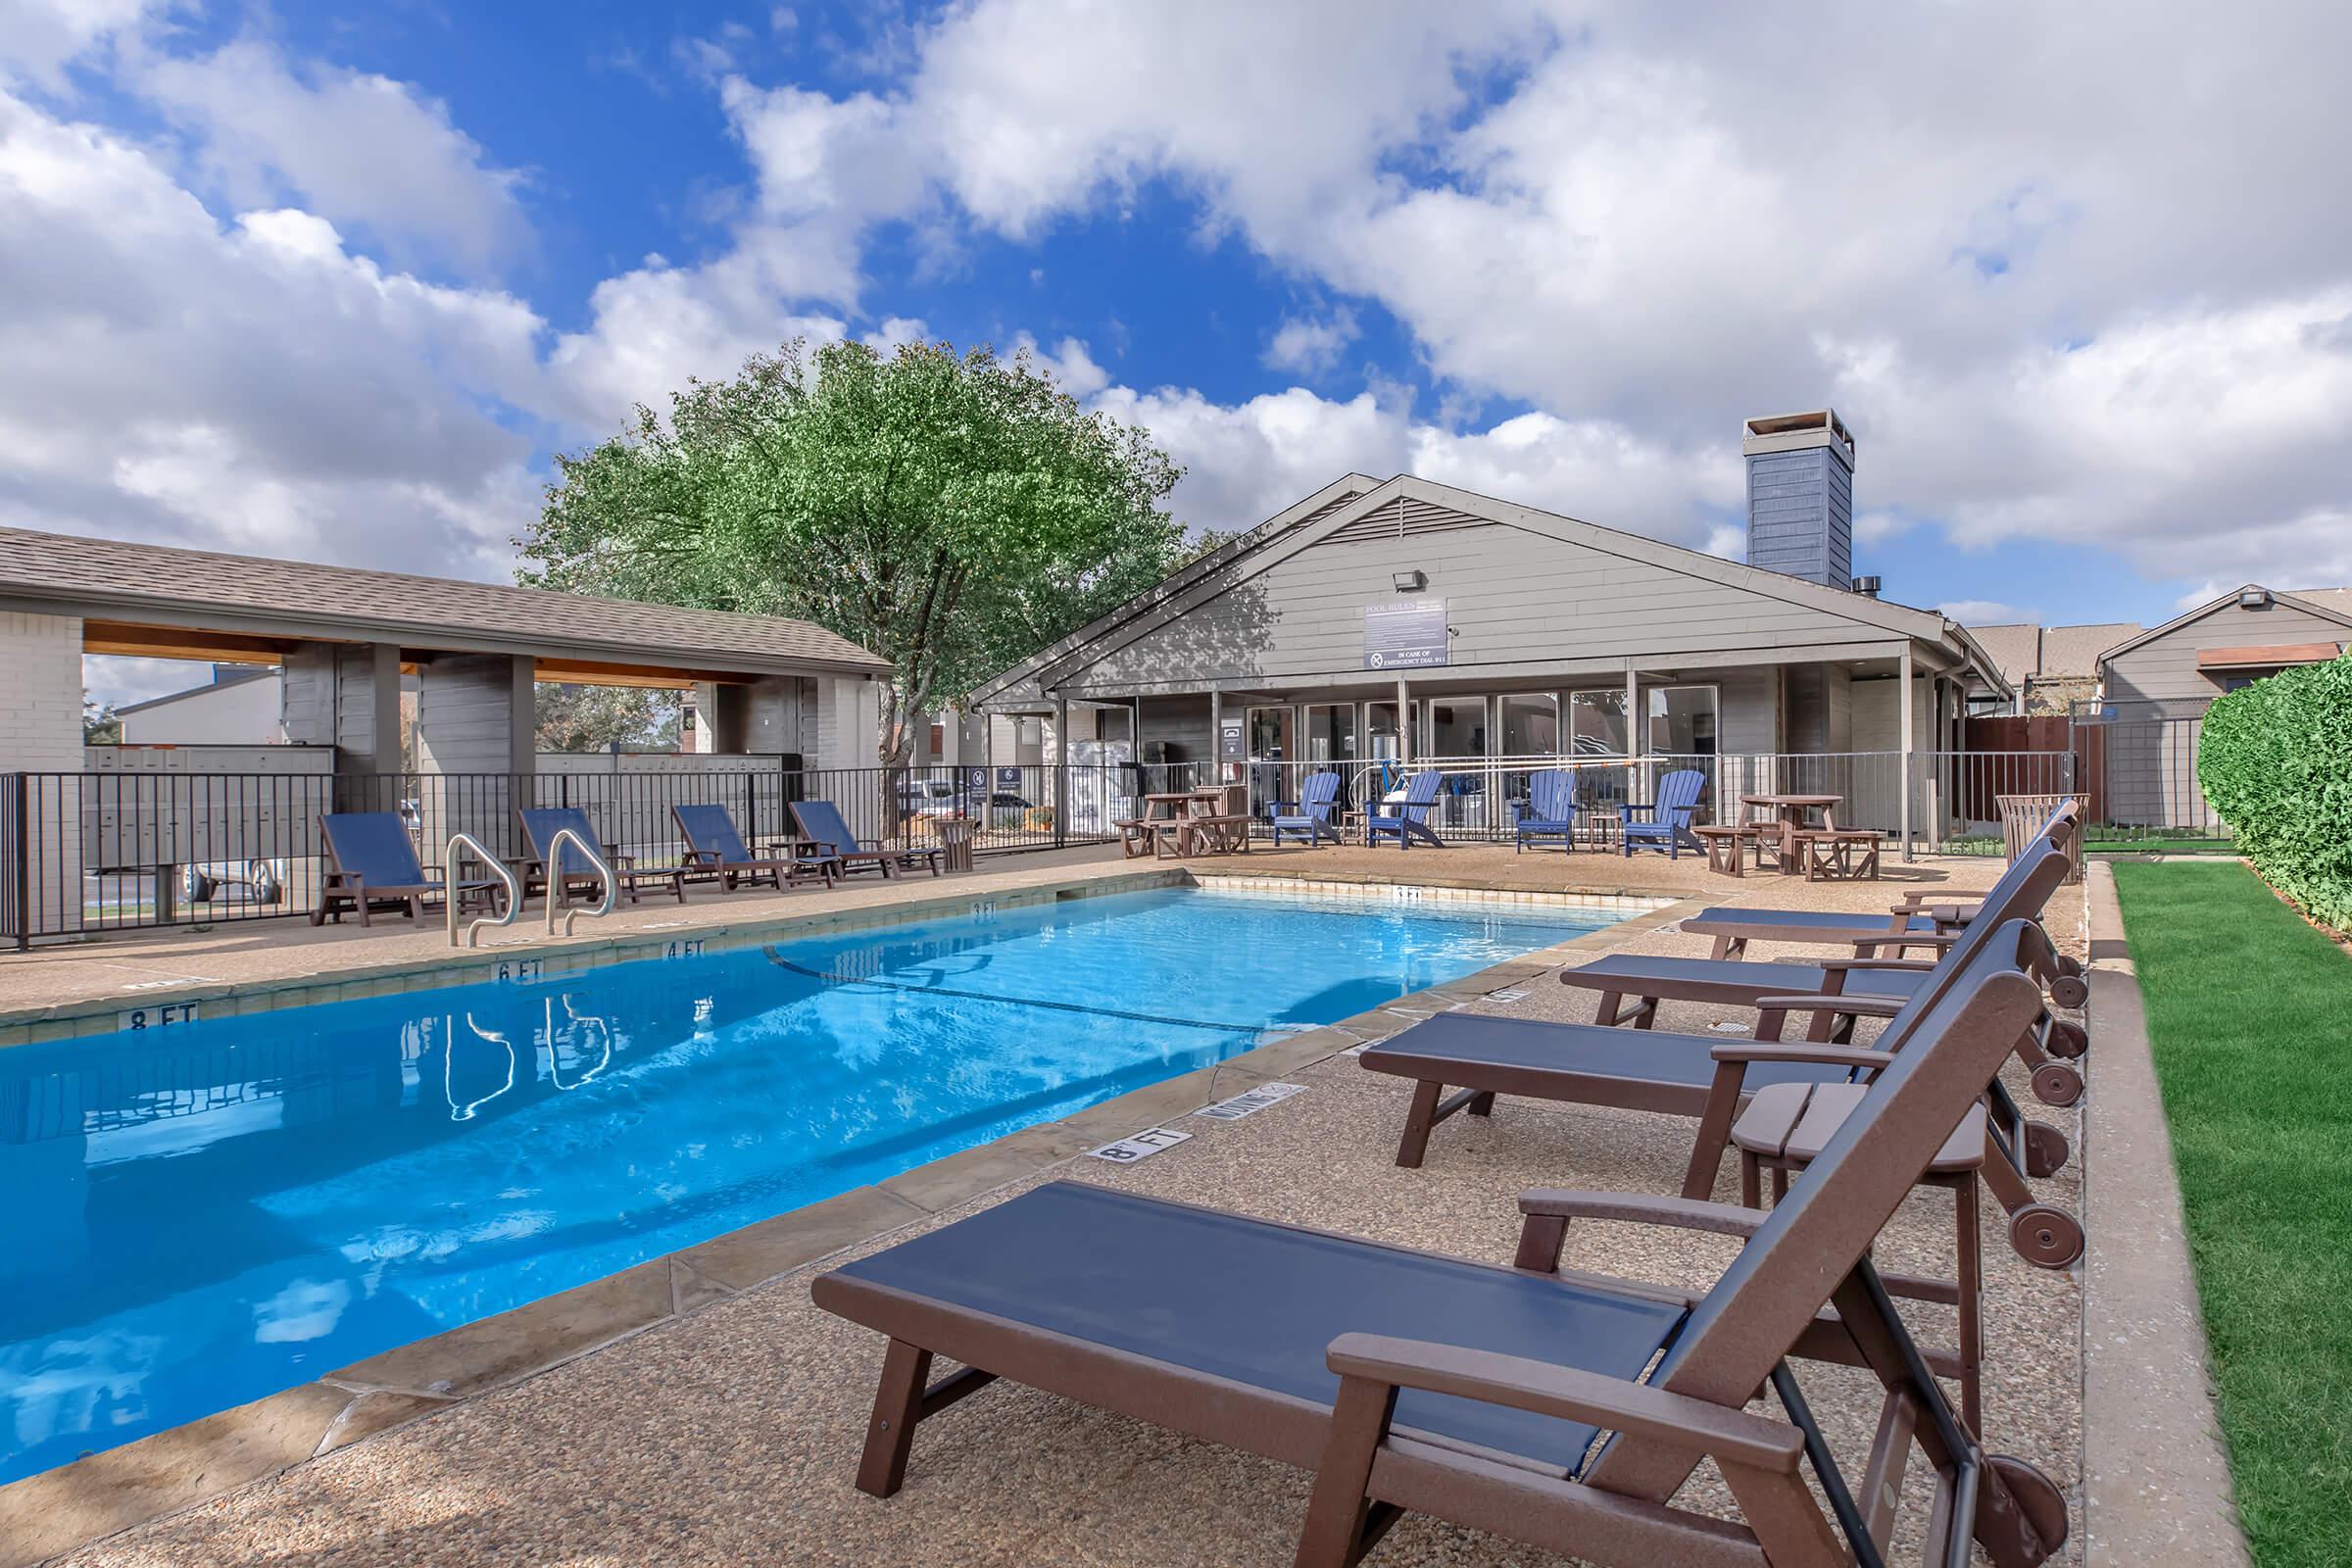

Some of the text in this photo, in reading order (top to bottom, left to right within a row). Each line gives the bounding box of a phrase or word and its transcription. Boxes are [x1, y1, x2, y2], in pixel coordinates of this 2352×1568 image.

[667, 940, 704, 956] 4 FT
[499, 958, 543, 980] 6 FT
[130, 1003, 197, 1031] 8 FT
[1101, 1149, 1137, 1159] 8
[1132, 1130, 1180, 1147] FT
